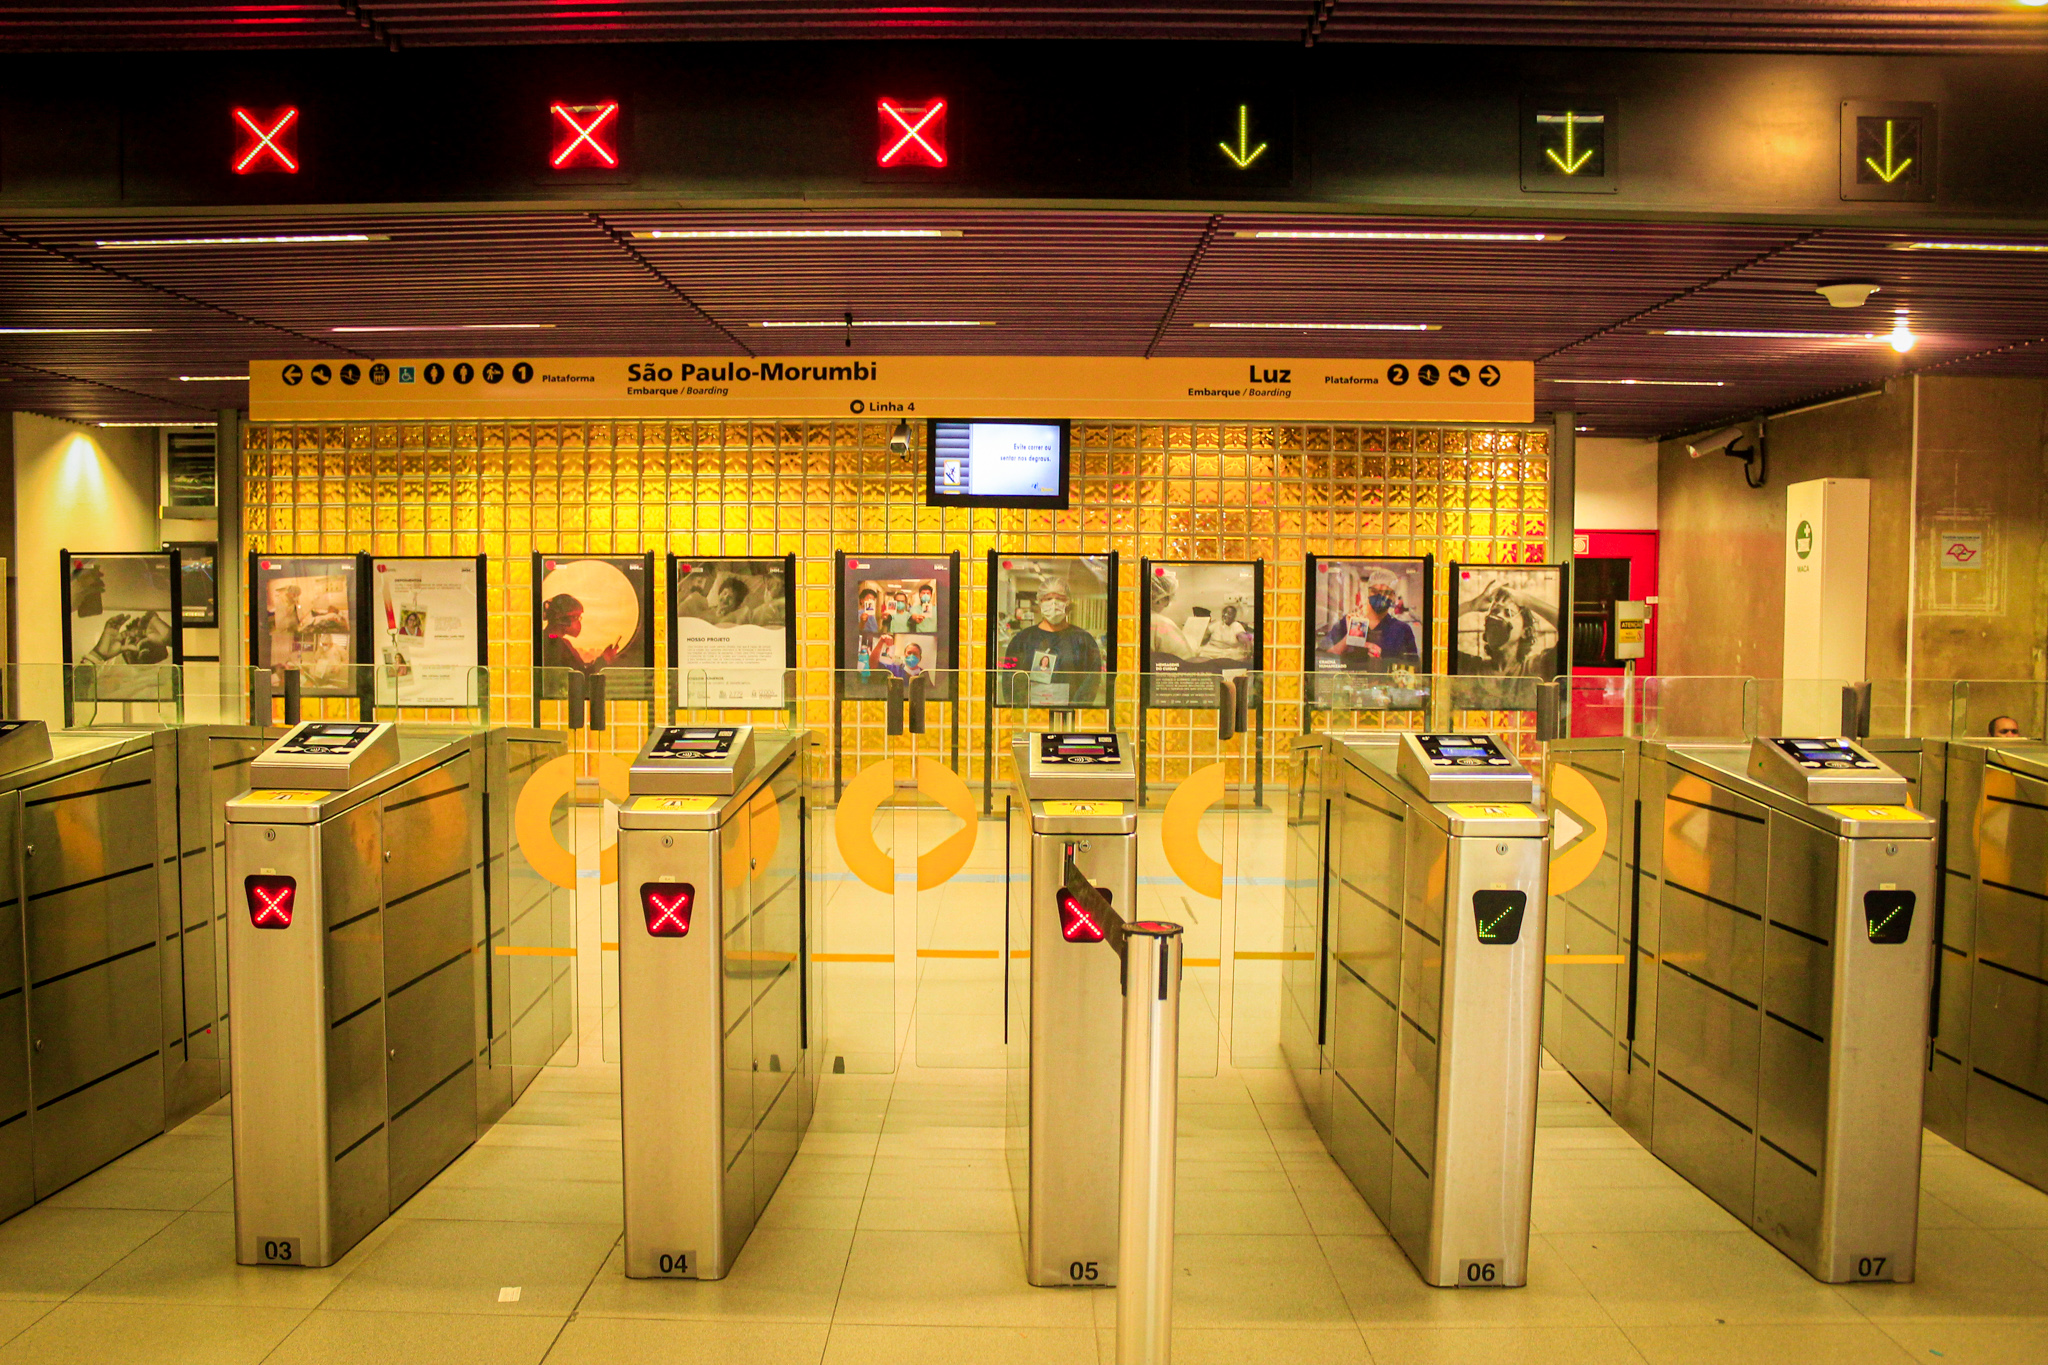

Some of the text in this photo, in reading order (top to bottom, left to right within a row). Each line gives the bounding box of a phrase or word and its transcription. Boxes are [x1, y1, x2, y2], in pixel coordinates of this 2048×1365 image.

[542, 373, 595, 383] Plataforma
[627, 361, 877, 382] São Paulo-Morumbi
[1249, 364, 1292, 384] Luz
[1324, 375, 1379, 385] Plataforma
[627, 386, 679, 397] Embarque
[686, 386, 729, 397] Boarding
[1188, 387, 1241, 398] Embarque
[1249, 387, 1292, 399] Boarding
[869, 401, 916, 412] Linha 4
[264, 1240, 292, 1260] 03
[659, 1253, 688, 1274] 04
[1069, 1261, 1099, 1281] 05
[1466, 1262, 1495, 1282] 06
[1858, 1257, 1887, 1277] 07
